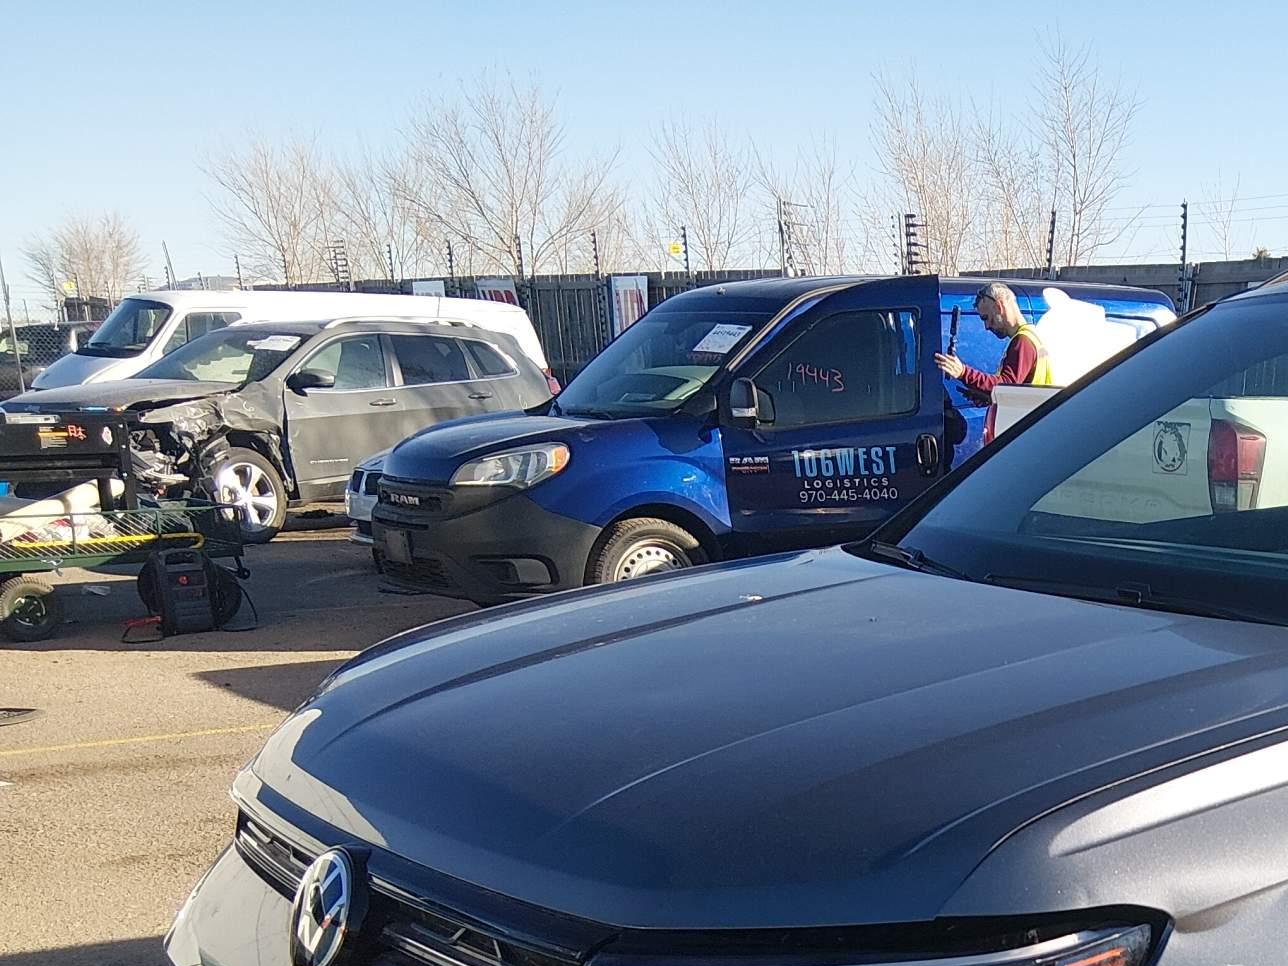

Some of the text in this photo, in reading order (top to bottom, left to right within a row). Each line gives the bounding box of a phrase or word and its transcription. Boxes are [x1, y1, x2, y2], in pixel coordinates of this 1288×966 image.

[787, 362, 845, 392] 19443
[804, 477, 889, 489] LOGISTICS
[390, 493, 420, 506] RAM
[799, 487, 898, 503] 970-445-4040
